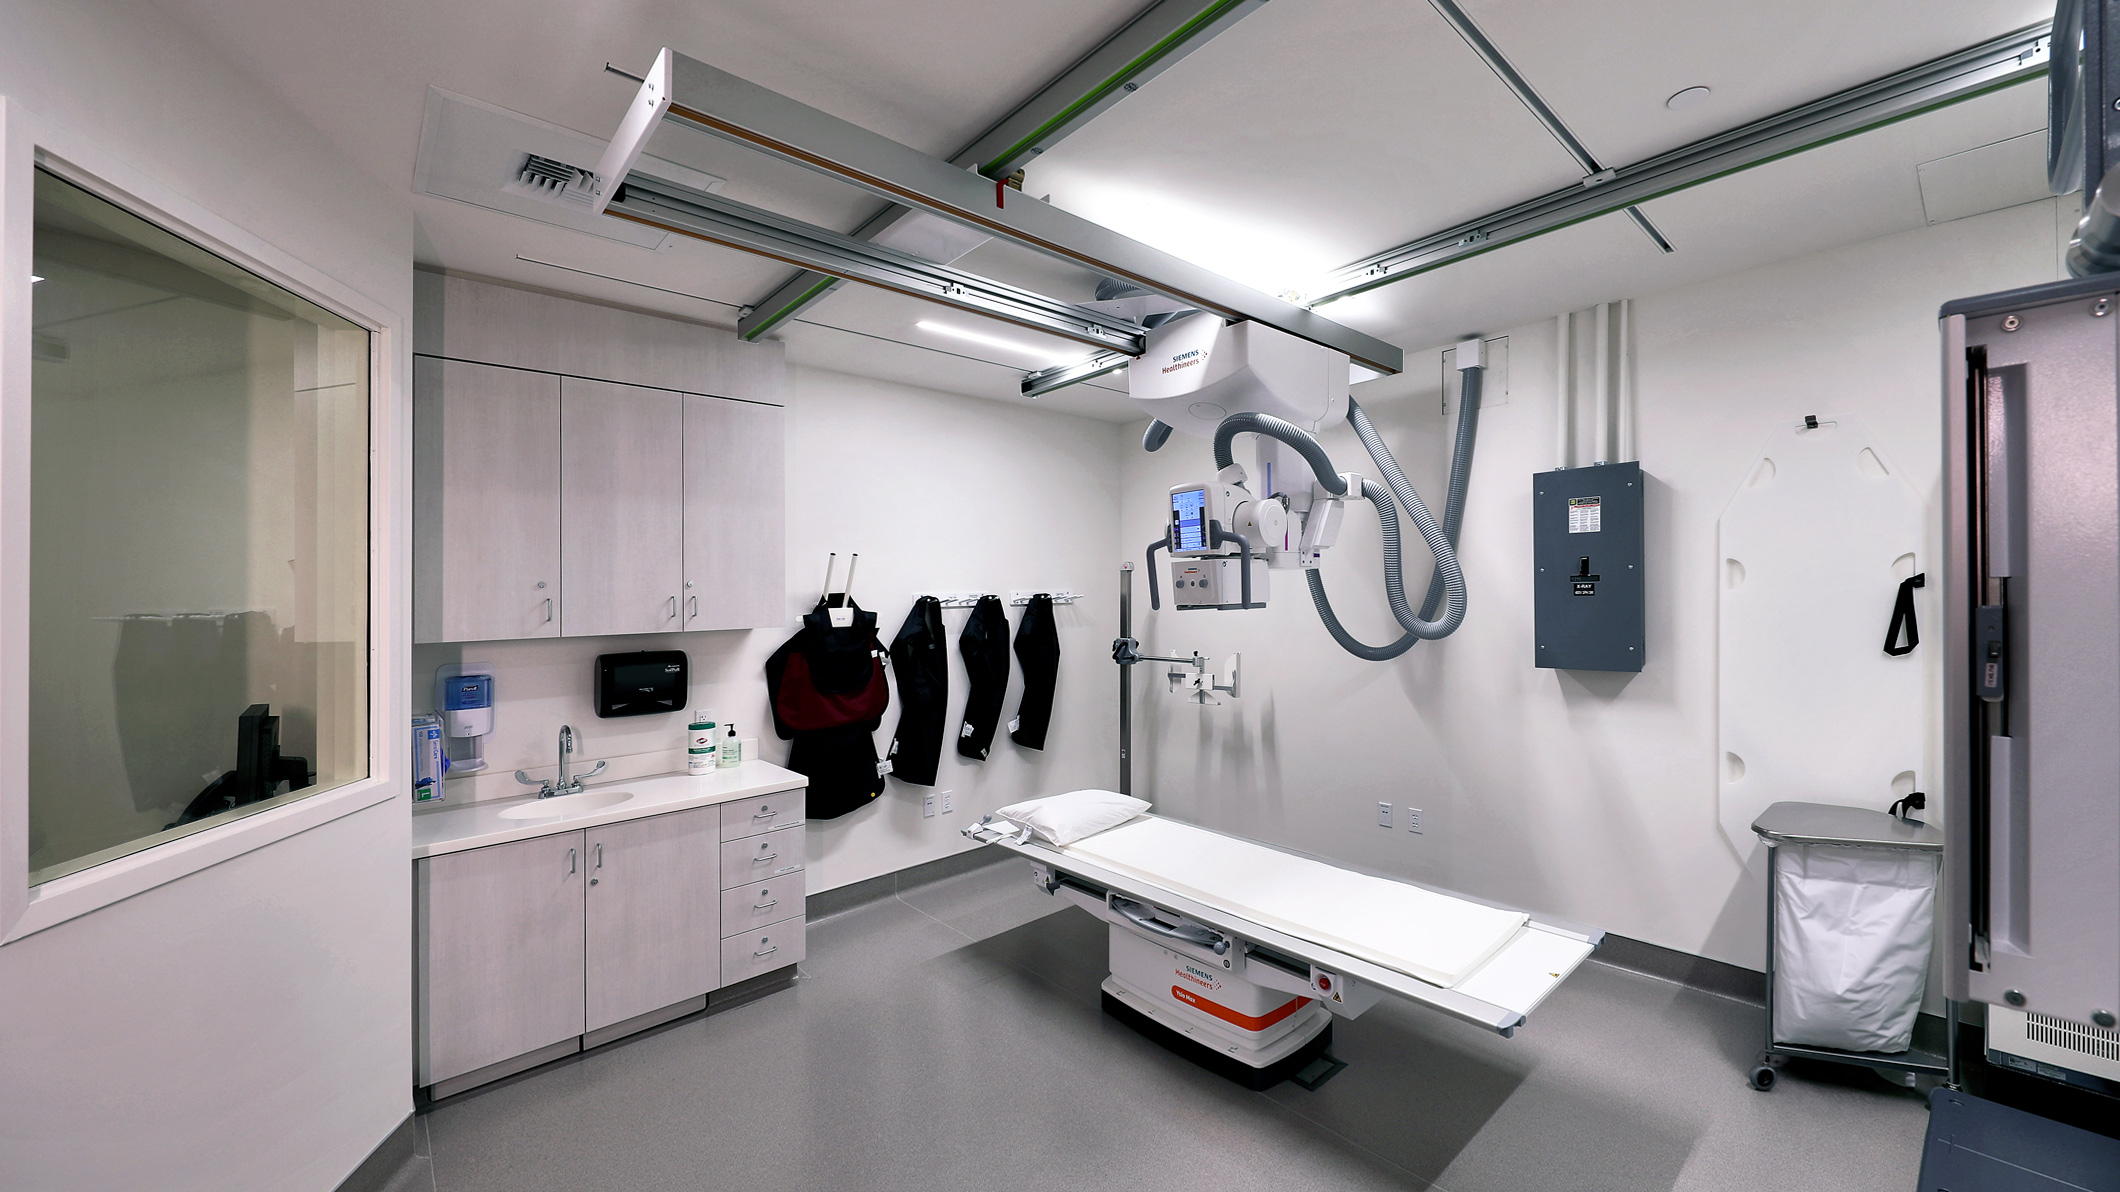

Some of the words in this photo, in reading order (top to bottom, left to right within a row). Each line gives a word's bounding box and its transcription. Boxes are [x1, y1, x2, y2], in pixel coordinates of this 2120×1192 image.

[1172, 349, 1199, 363] SIEMENS
[1162, 359, 1199, 374] Healthineers
[1175, 968, 1213, 990] Healthineers
[1185, 965, 1213, 981] SIEMENS
